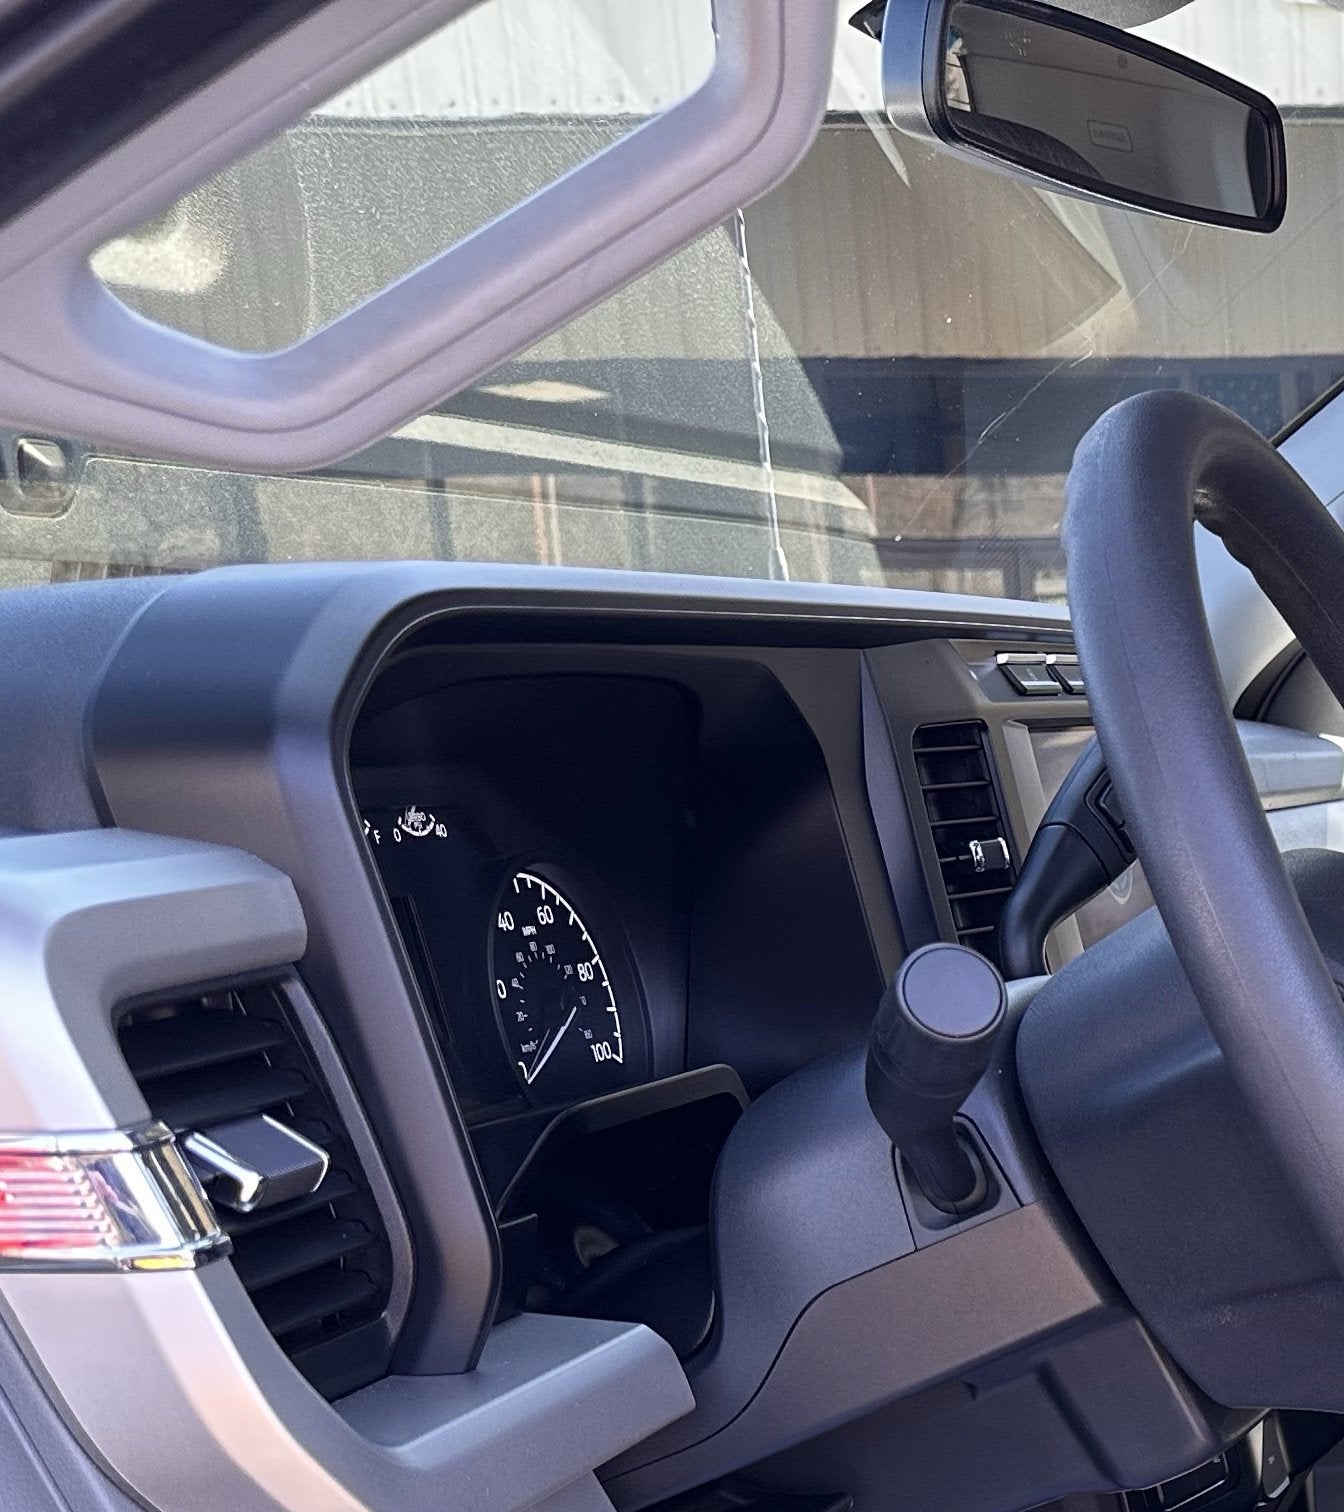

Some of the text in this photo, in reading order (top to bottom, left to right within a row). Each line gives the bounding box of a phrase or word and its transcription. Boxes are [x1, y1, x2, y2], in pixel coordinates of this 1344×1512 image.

[497, 911, 515, 932] 40
[536, 905, 554, 925] 60
[577, 961, 595, 982] 80
[590, 1041, 612, 1063] 100
